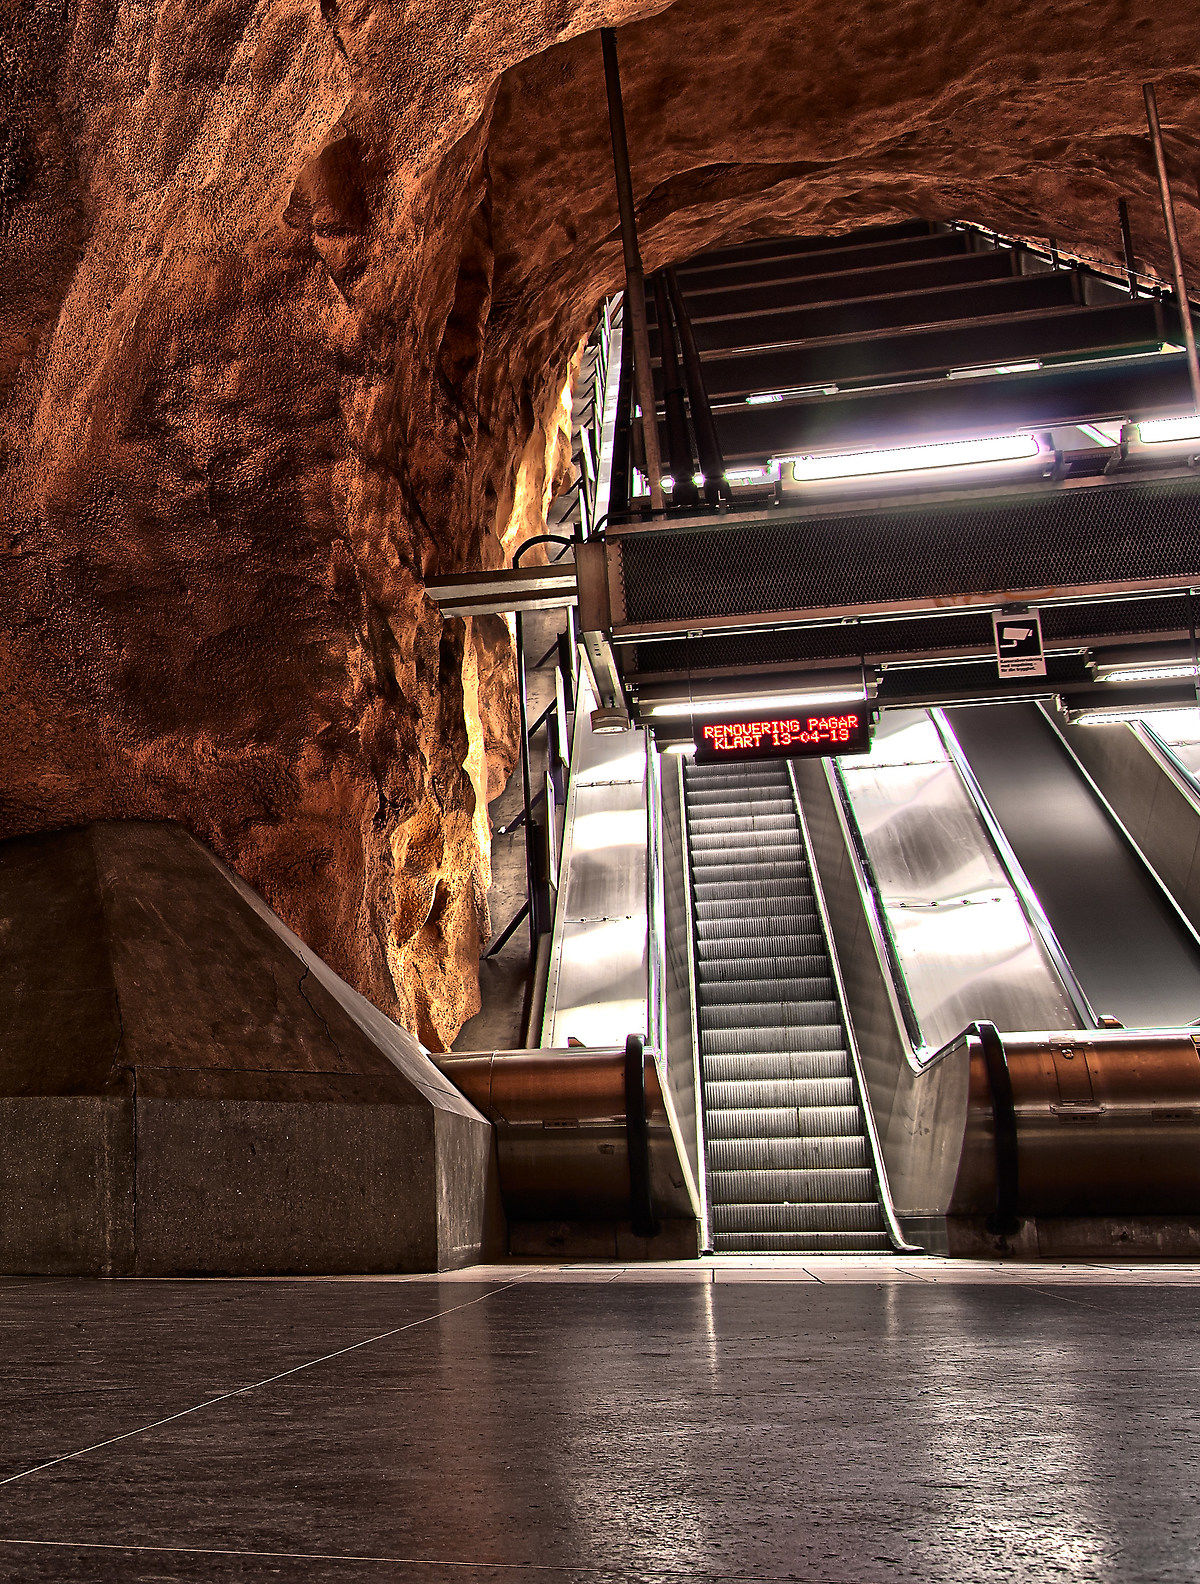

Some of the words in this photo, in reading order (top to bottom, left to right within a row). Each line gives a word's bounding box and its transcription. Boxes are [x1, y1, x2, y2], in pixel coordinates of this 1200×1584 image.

[704, 720, 800, 738] RENOVERING
[714, 735, 762, 750] KLART
[772, 728, 850, 746] 13-04-19
